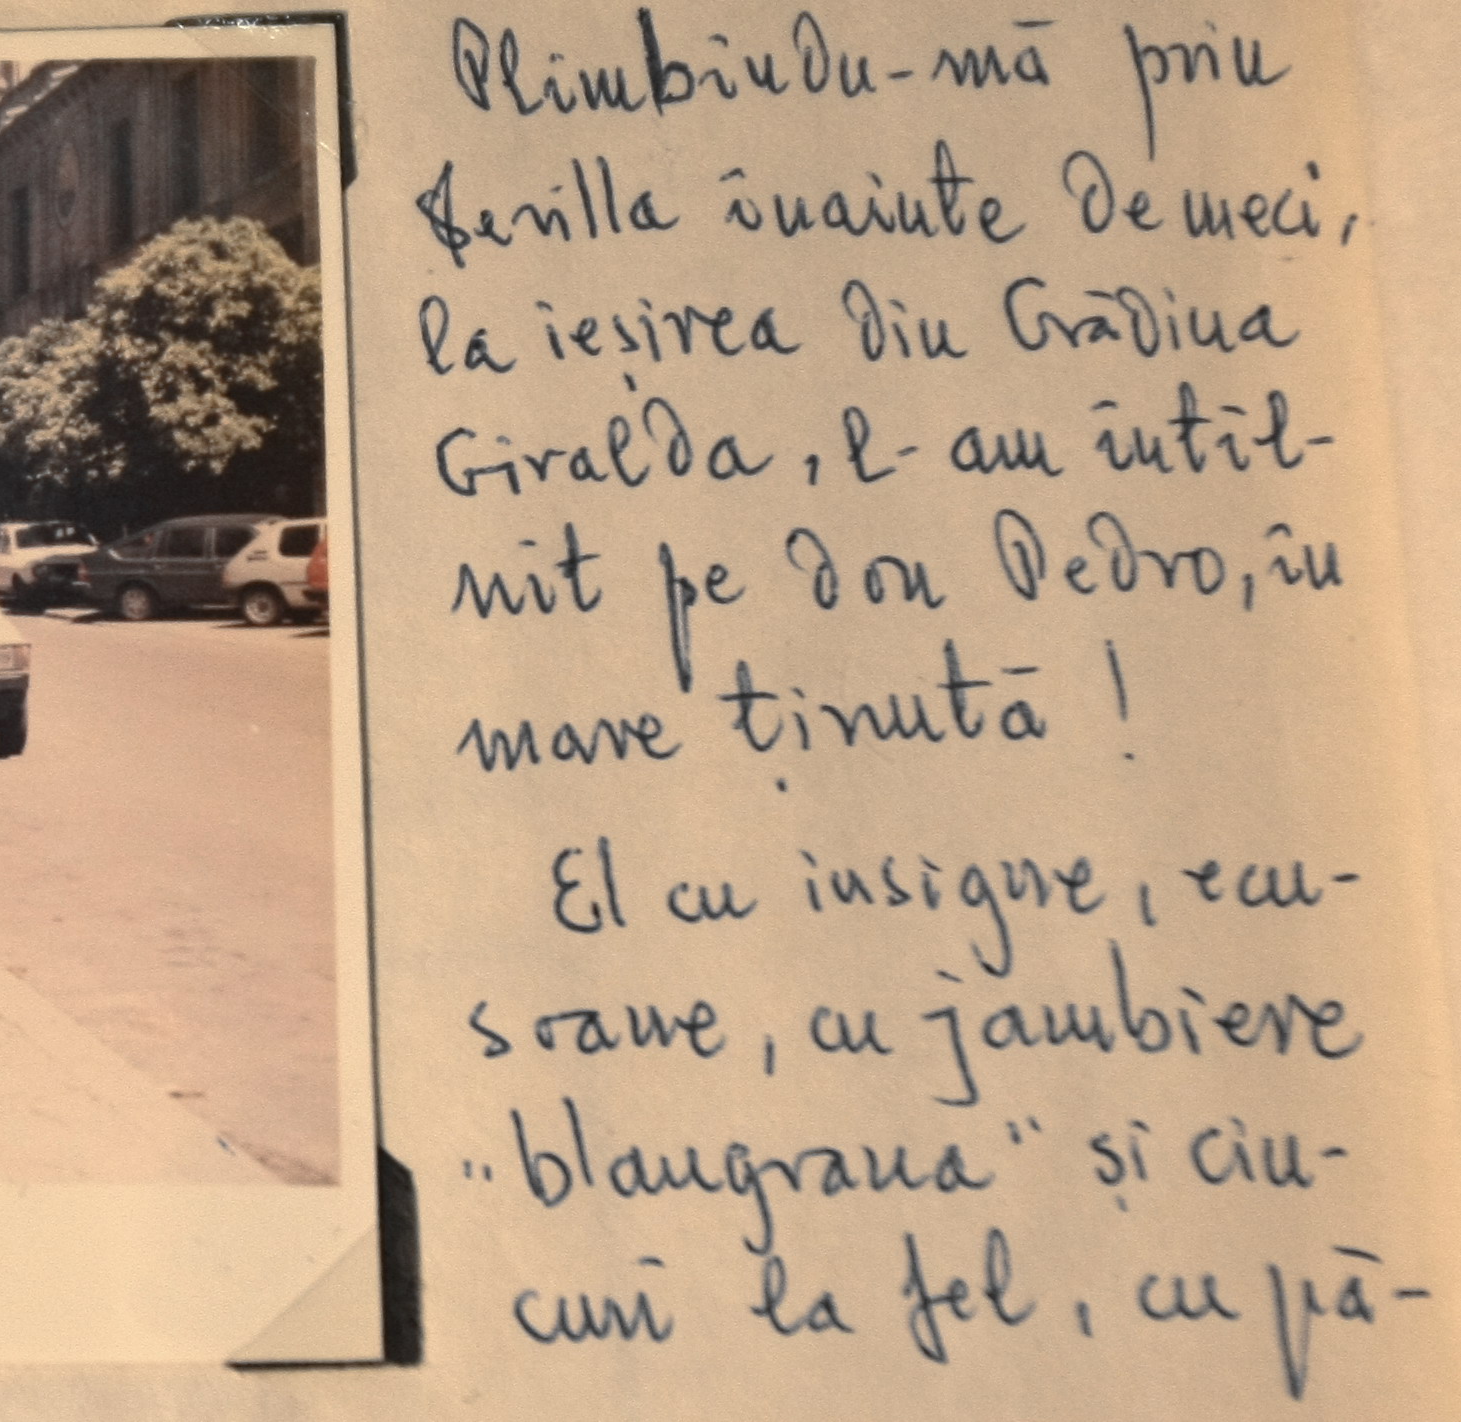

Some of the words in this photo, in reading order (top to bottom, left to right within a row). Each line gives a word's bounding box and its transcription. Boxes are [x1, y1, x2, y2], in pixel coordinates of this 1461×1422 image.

[1121, 19, 1293, 163] prin
[413, 154, 681, 271] Sevilla
[717, 138, 1028, 246] înainte
[1060, 149, 1165, 241] de
[417, 293, 518, 377] la
[839, 278, 970, 363] din
[449, 521, 604, 621] nit
[656, 540, 747, 695] pe
[783, 526, 948, 611] don
[454, 711, 684, 774] mare
[549, 835, 629, 936] El
[664, 880, 759, 926] cu
[807, 1004, 896, 1057] cu
[919, 937, 1366, 1109] jambiere
[752, 1256, 856, 1338] la
[1134, 1271, 1243, 1323] cu
